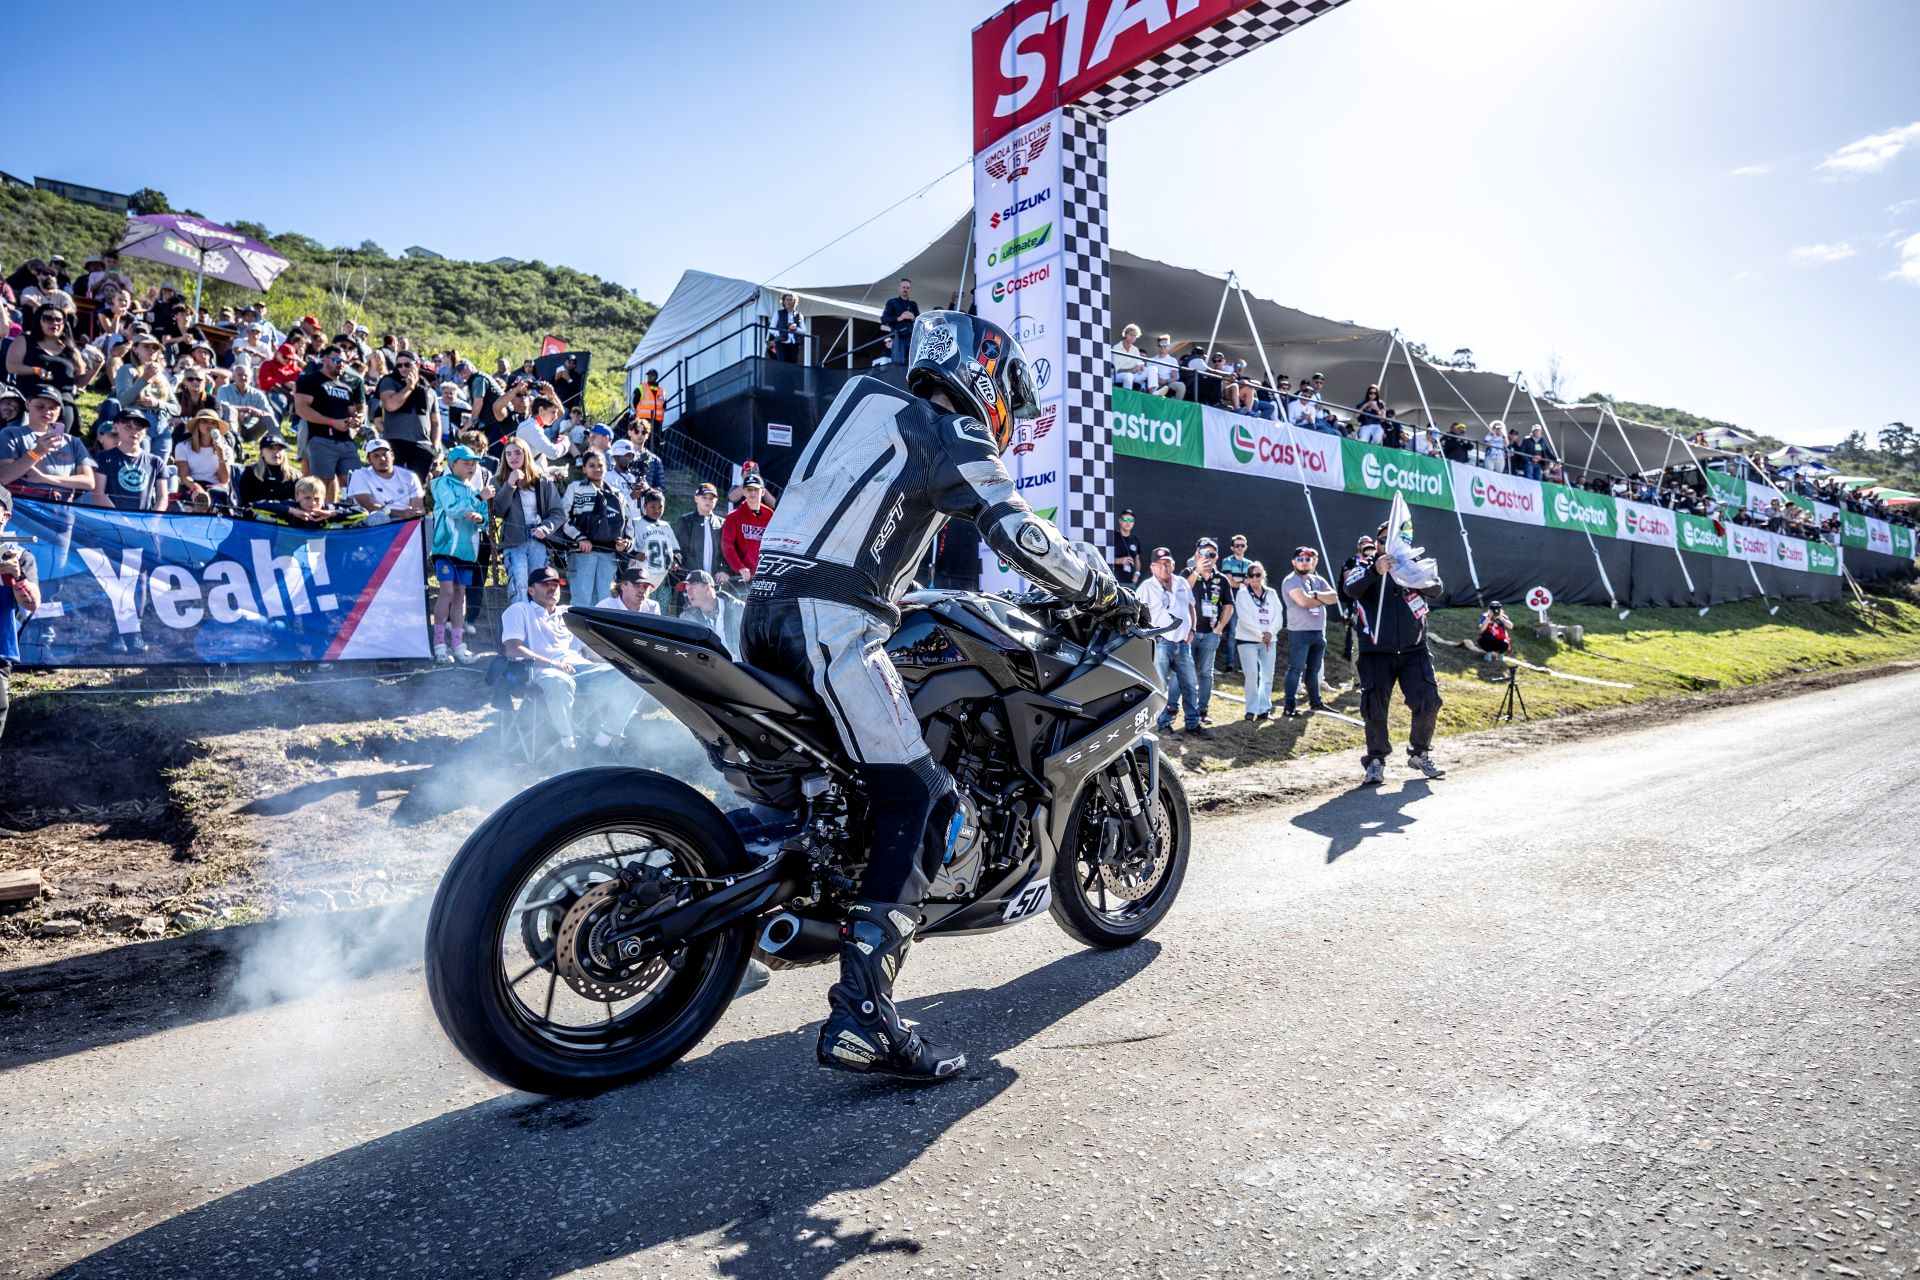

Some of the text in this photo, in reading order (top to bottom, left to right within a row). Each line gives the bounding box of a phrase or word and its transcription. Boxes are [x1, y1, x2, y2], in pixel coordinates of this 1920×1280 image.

[993, 0, 1200, 118] STA
[984, 122, 1052, 167] SIMOLA HILLCLIMB
[1012, 154, 1022, 169] 15
[1003, 187, 1051, 221] SUZUKI
[1002, 237, 1038, 259] ultimate
[1007, 264, 1050, 294] Castrol
[323, 384, 350, 400] VANS
[969, 367, 995, 404] X-lite
[1017, 428, 1027, 443] 15
[1112, 410, 1182, 446] astrol
[1258, 436, 1327, 472] Castrol
[1016, 471, 1056, 489] UZUKI
[1382, 463, 1443, 496] Castrol
[1487, 484, 1534, 512] Castrol
[870, 492, 905, 565] RST
[1568, 502, 1608, 527] Castrol
[1638, 515, 1670, 537] Castrol
[755, 553, 818, 576] ST
[76, 538, 338, 634] Yeah!
[1009, 883, 1049, 920] 50
